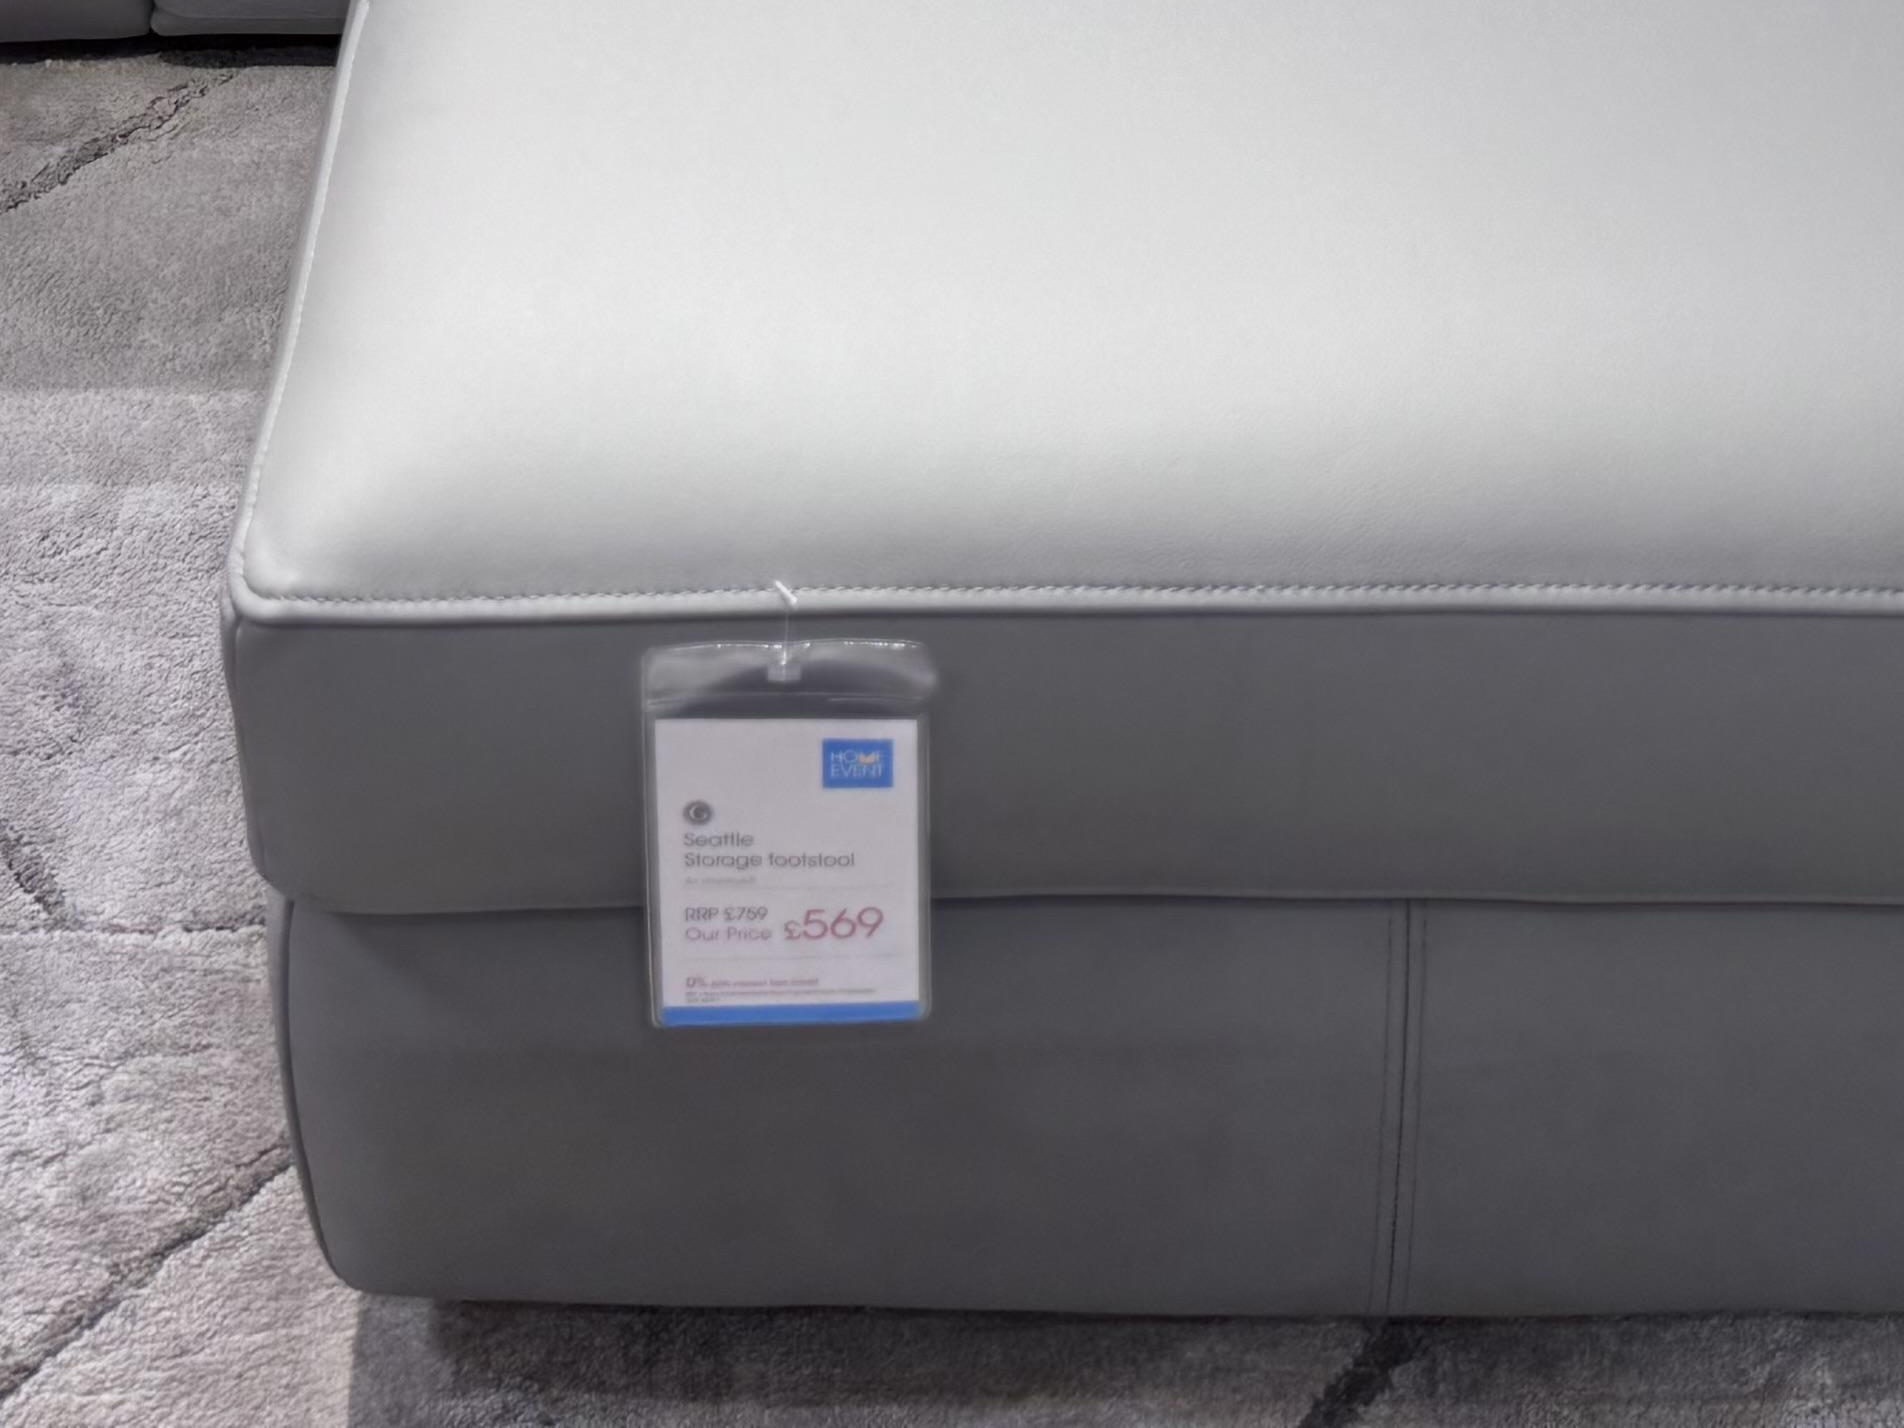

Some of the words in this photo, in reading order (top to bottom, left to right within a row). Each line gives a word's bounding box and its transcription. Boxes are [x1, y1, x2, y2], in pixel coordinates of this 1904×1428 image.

[683, 831, 755, 848] Seattle
[684, 852, 763, 870] Storage
[767, 852, 856, 868] footstool
[684, 906, 720, 922] RRP
[783, 905, 885, 941] £569
[685, 926, 720, 942] Our
[726, 926, 773, 942] Price
